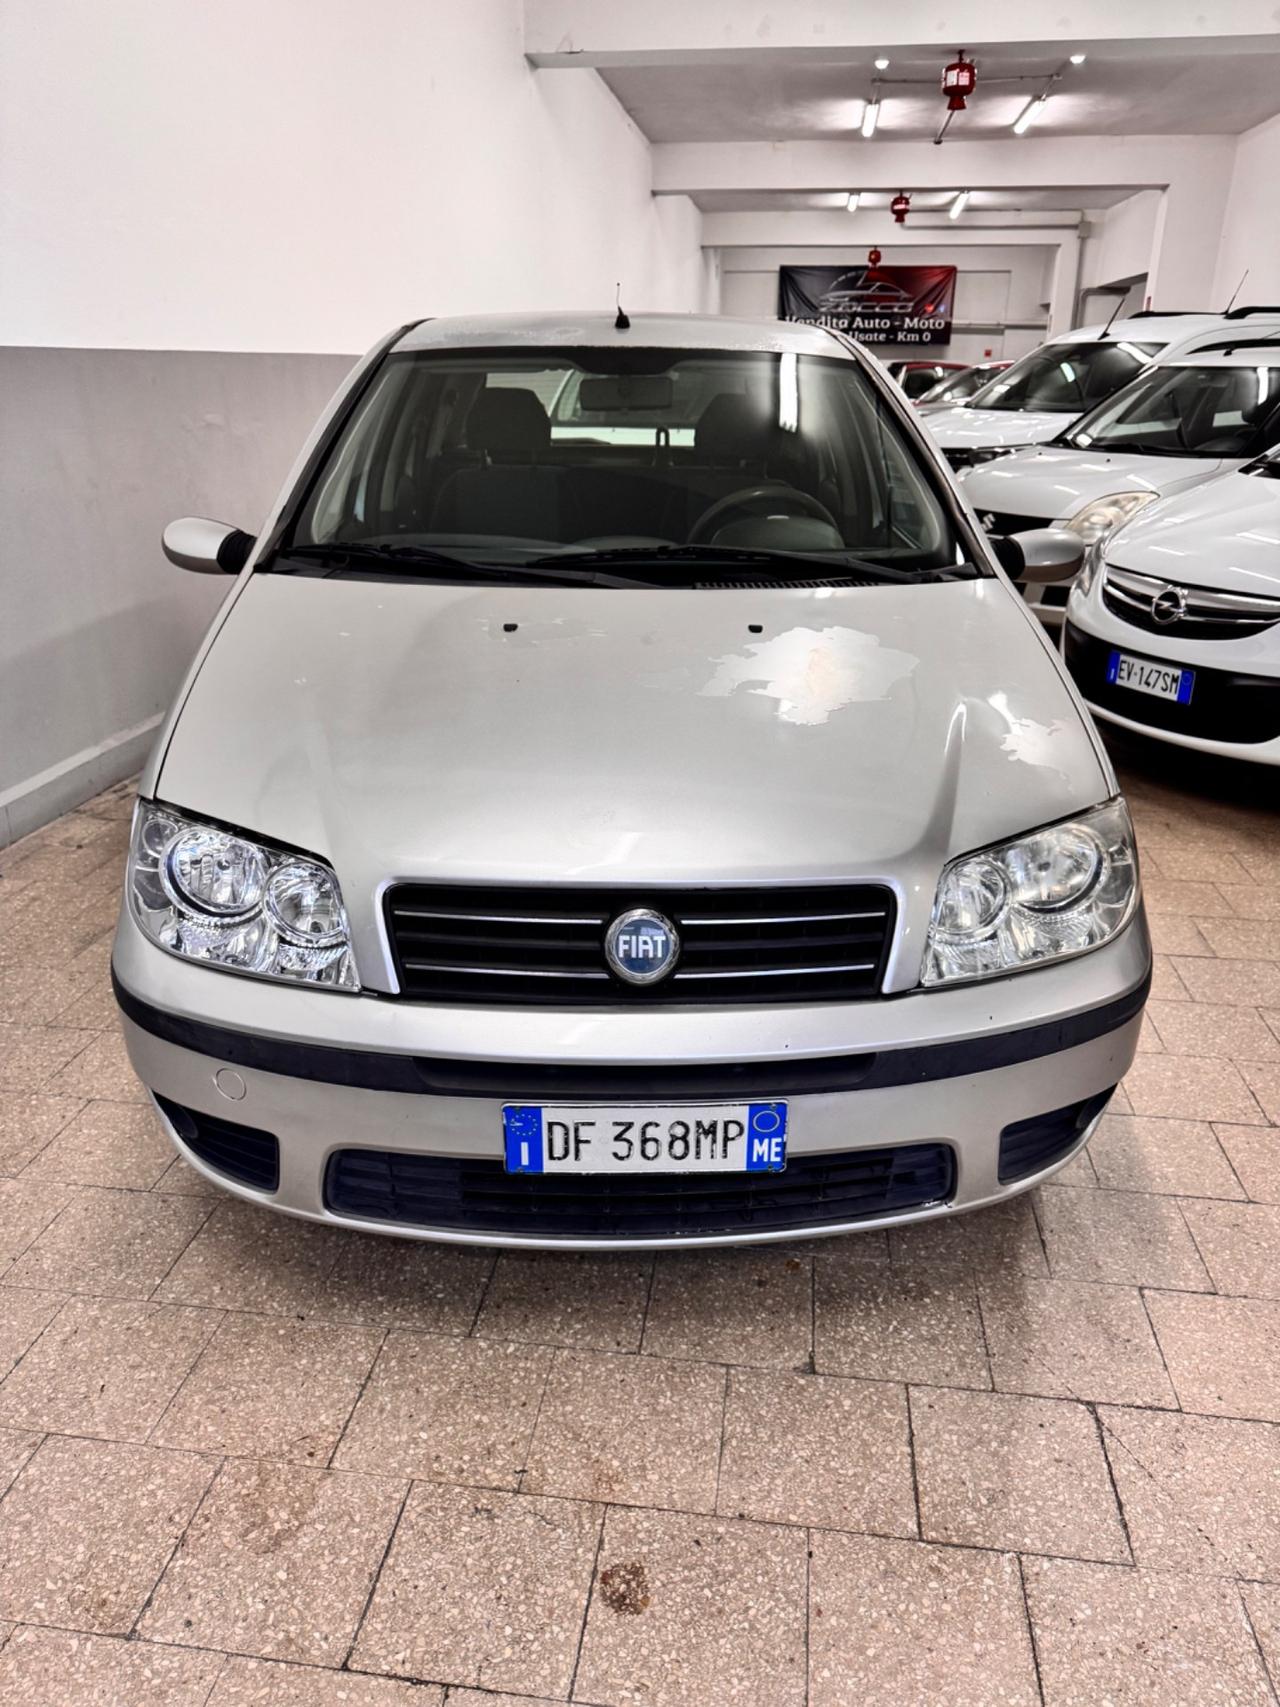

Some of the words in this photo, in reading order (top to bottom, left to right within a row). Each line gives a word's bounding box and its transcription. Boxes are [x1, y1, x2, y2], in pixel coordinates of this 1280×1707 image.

[852, 317, 890, 329] Auto
[903, 317, 945, 329] Moto
[849, 331, 887, 341] Usate
[897, 331, 919, 341] Km
[922, 332, 931, 342] 0
[618, 935, 666, 958] FIAT
[520, 1142, 529, 1165] I
[547, 1121, 596, 1161] DF
[611, 1119, 745, 1161] 368MP
[752, 1137, 781, 1162] ME
